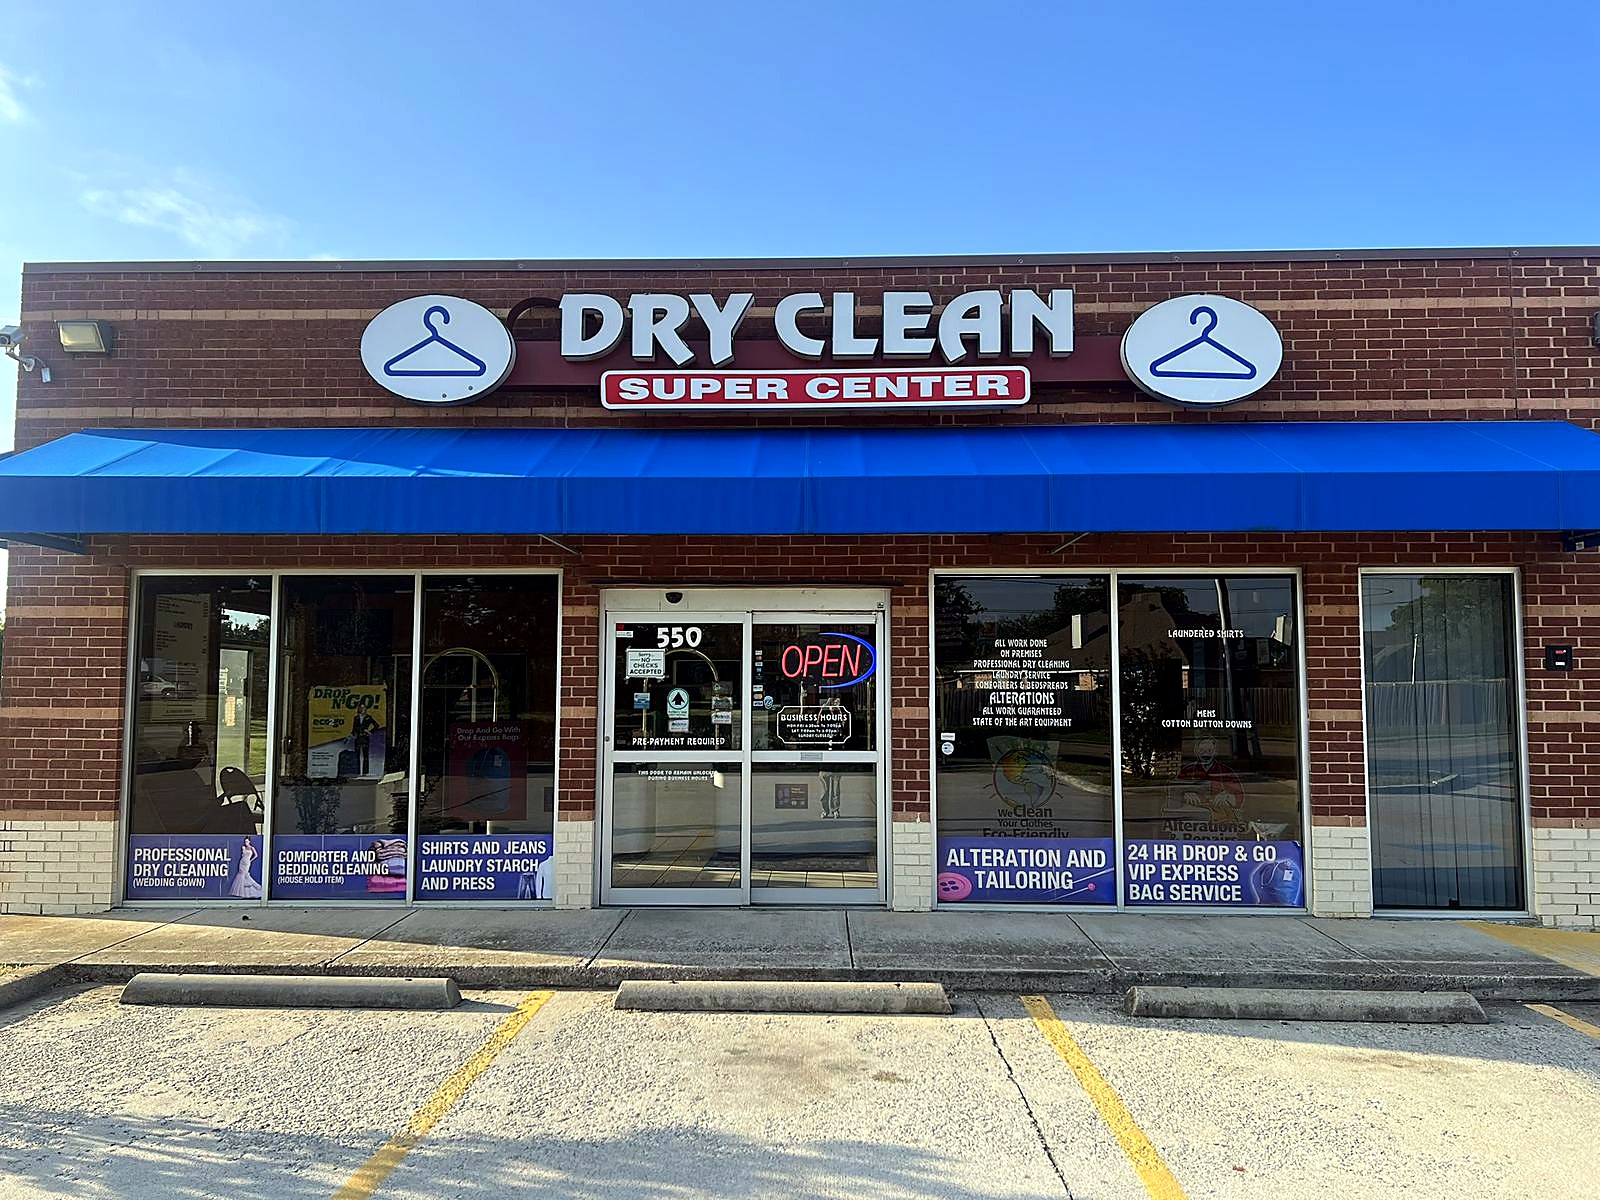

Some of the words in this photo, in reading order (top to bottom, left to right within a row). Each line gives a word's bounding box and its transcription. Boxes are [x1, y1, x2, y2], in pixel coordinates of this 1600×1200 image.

[559, 292, 754, 367] DRY
[774, 289, 1074, 364] CLEAN
[618, 377, 788, 400] SUPER
[805, 375, 1010, 399] CENTER
[656, 627, 702, 648] 550
[1168, 629, 1214, 638] LAUNDERED
[1216, 629, 1244, 638] SHIRTS
[994, 639, 1006, 647] ALL
[1007, 639, 1028, 647] WORK
[1029, 639, 1048, 647] DONE
[1000, 650, 1010, 658] ON
[1011, 650, 1042, 658] PREMISES
[781, 644, 861, 678] OPEN
[973, 660, 1021, 669] PROFESSIONAL
[1022, 660, 1037, 668] DRY
[1037, 660, 1070, 669] CLEANING
[992, 671, 1023, 680] LAUNDRY
[1024, 671, 1051, 680] SERVICE
[975, 681, 1018, 690] COMFORTERS
[1026, 682, 1069, 690] BEDSPREADS
[313, 688, 351, 699] DROP
[989, 692, 1055, 705] ALTERATIONS
[982, 707, 994, 716] ALL
[995, 707, 1016, 716] WORK
[1017, 707, 1062, 716] GUARANTEED
[1196, 710, 1216, 718] MENS
[780, 714, 818, 722] BUSINESS
[820, 714, 848, 722] HOURS
[972, 718, 993, 726] STATE
[994, 718, 1003, 726] OF
[1004, 718, 1018, 726] THE
[1019, 718, 1033, 726] ART
[1034, 718, 1072, 727] EQUIPMENT
[1161, 720, 1191, 728] COTTON
[1193, 720, 1223, 728] BUTTON
[1225, 720, 1252, 728] DOWNS
[632, 737, 685, 746] PRE-PAYMENT
[687, 737, 725, 746] REQUIRED
[997, 808, 1013, 818] We
[1013, 804, 1053, 818] Clean
[997, 819, 1018, 827] Your
[1020, 818, 1054, 828] Clothes
[1162, 820, 1246, 833] Alterations
[982, 827, 1070, 838] Eco-Friendly
[422, 841, 469, 855] SHIRTS
[472, 841, 500, 854] AND
[503, 841, 547, 854] JEANS
[1128, 844, 1149, 861] 24
[1153, 845, 1177, 861] HR
[1182, 845, 1230, 861] DROP
[1234, 846, 1248, 862] &
[1253, 846, 1277, 862] GO
[134, 848, 231, 862] PROFESSIONAL
[278, 850, 348, 862] COMFORTER
[351, 850, 376, 862] AND
[946, 848, 1061, 868] ALTERATION
[1066, 849, 1106, 868] AND
[133, 863, 161, 877] DRY
[164, 863, 229, 877] CLEANING
[278, 863, 329, 875] BEDDING
[332, 863, 389, 875] CLEANING
[421, 859, 482, 873] LAUNDRY
[486, 859, 539, 872] STARCH
[1128, 863, 1156, 881] VIP
[1161, 864, 1239, 882] EXPRESS
[132, 878, 175, 888] (WEDDING
[176, 878, 206, 888] GOWN)
[277, 876, 303, 885] (HOUSE
[304, 876, 324, 884] HOLD
[324, 876, 345, 885] ITEM)
[421, 877, 449, 890] AND
[452, 877, 495, 890] PRESS
[974, 871, 1074, 890] TAILORING
[1129, 884, 1165, 901] BAG
[1169, 884, 1242, 902] SERVICE
